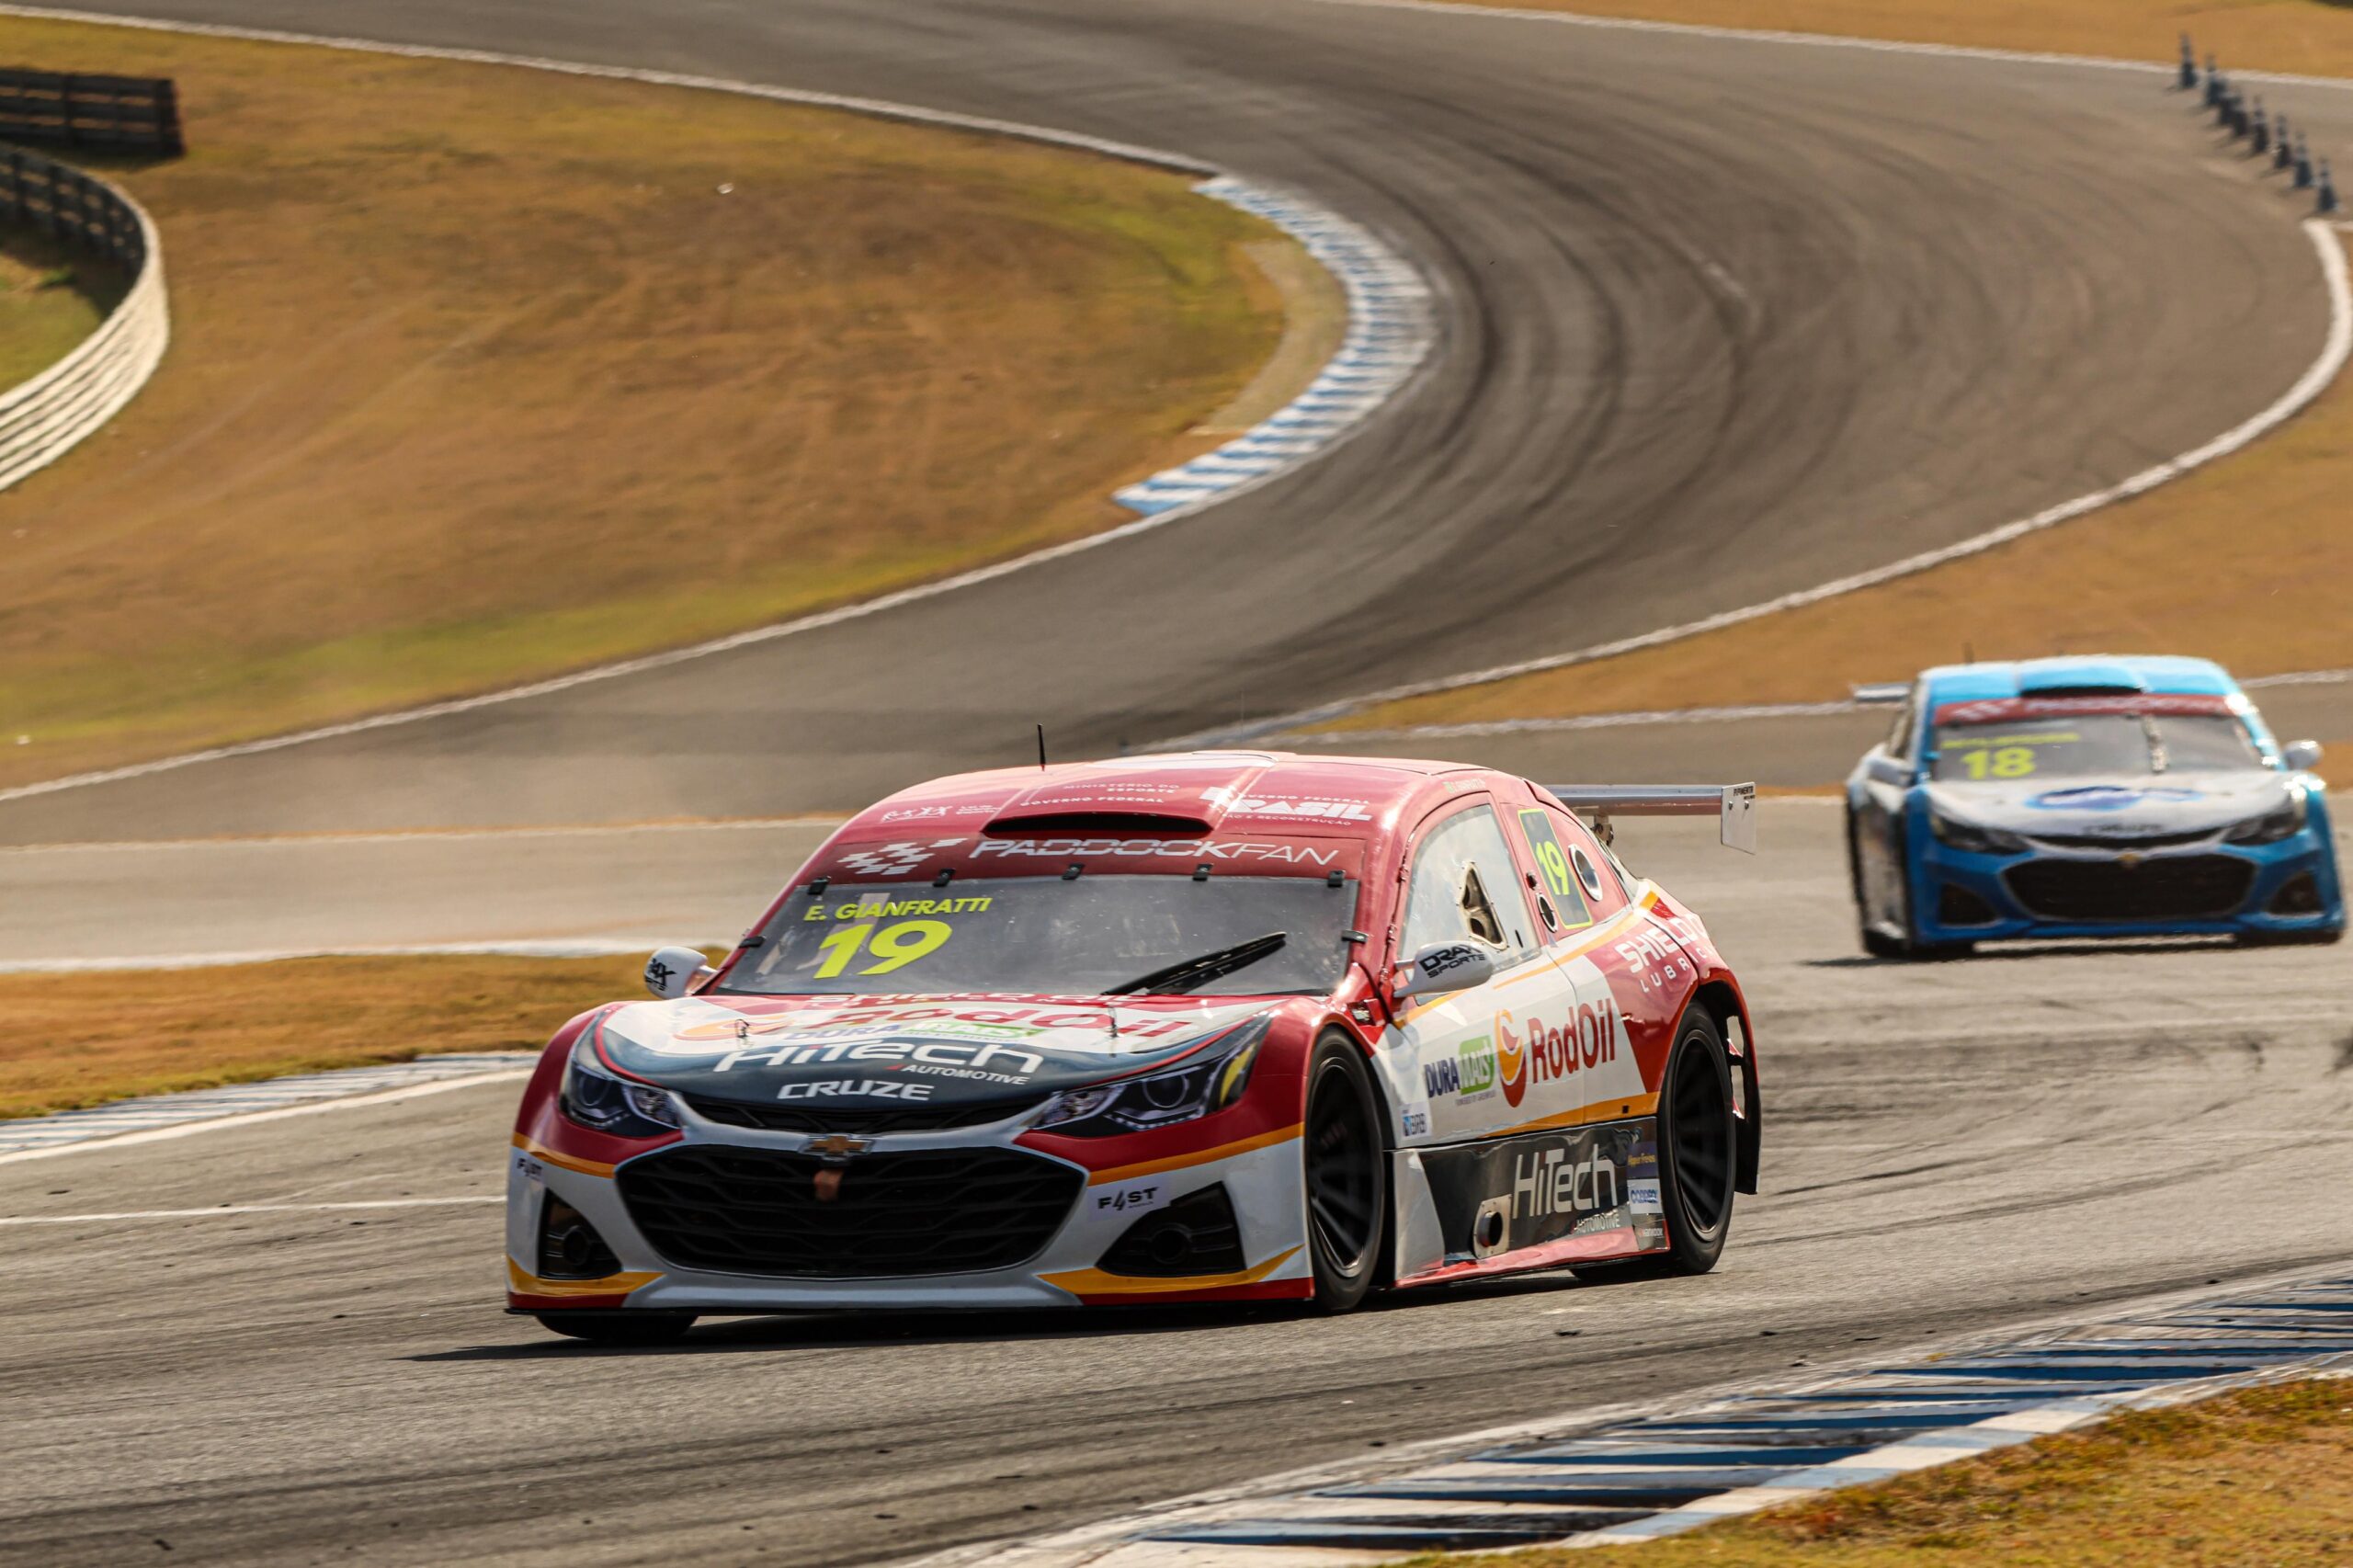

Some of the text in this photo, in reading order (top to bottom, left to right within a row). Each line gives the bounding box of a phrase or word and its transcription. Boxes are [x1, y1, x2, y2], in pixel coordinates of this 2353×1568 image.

[1962, 746, 2037, 780] 18
[1019, 796, 1093, 807] GOVERNO
[1303, 795, 1370, 805] FEDERAL
[1536, 840, 1570, 896] 19
[802, 897, 993, 922] E. GIANFRATTI
[813, 919, 953, 979] 19
[1614, 916, 1699, 973] SHIELD
[1427, 953, 1486, 979] SPORTS
[713, 1039, 1044, 1073] HiTech
[1527, 997, 1616, 1085] RodOil
[777, 1079, 935, 1102] CRUZE
[901, 1063, 1030, 1085] AUTOMOTIVE
[1512, 1142, 1619, 1220] HiTech
